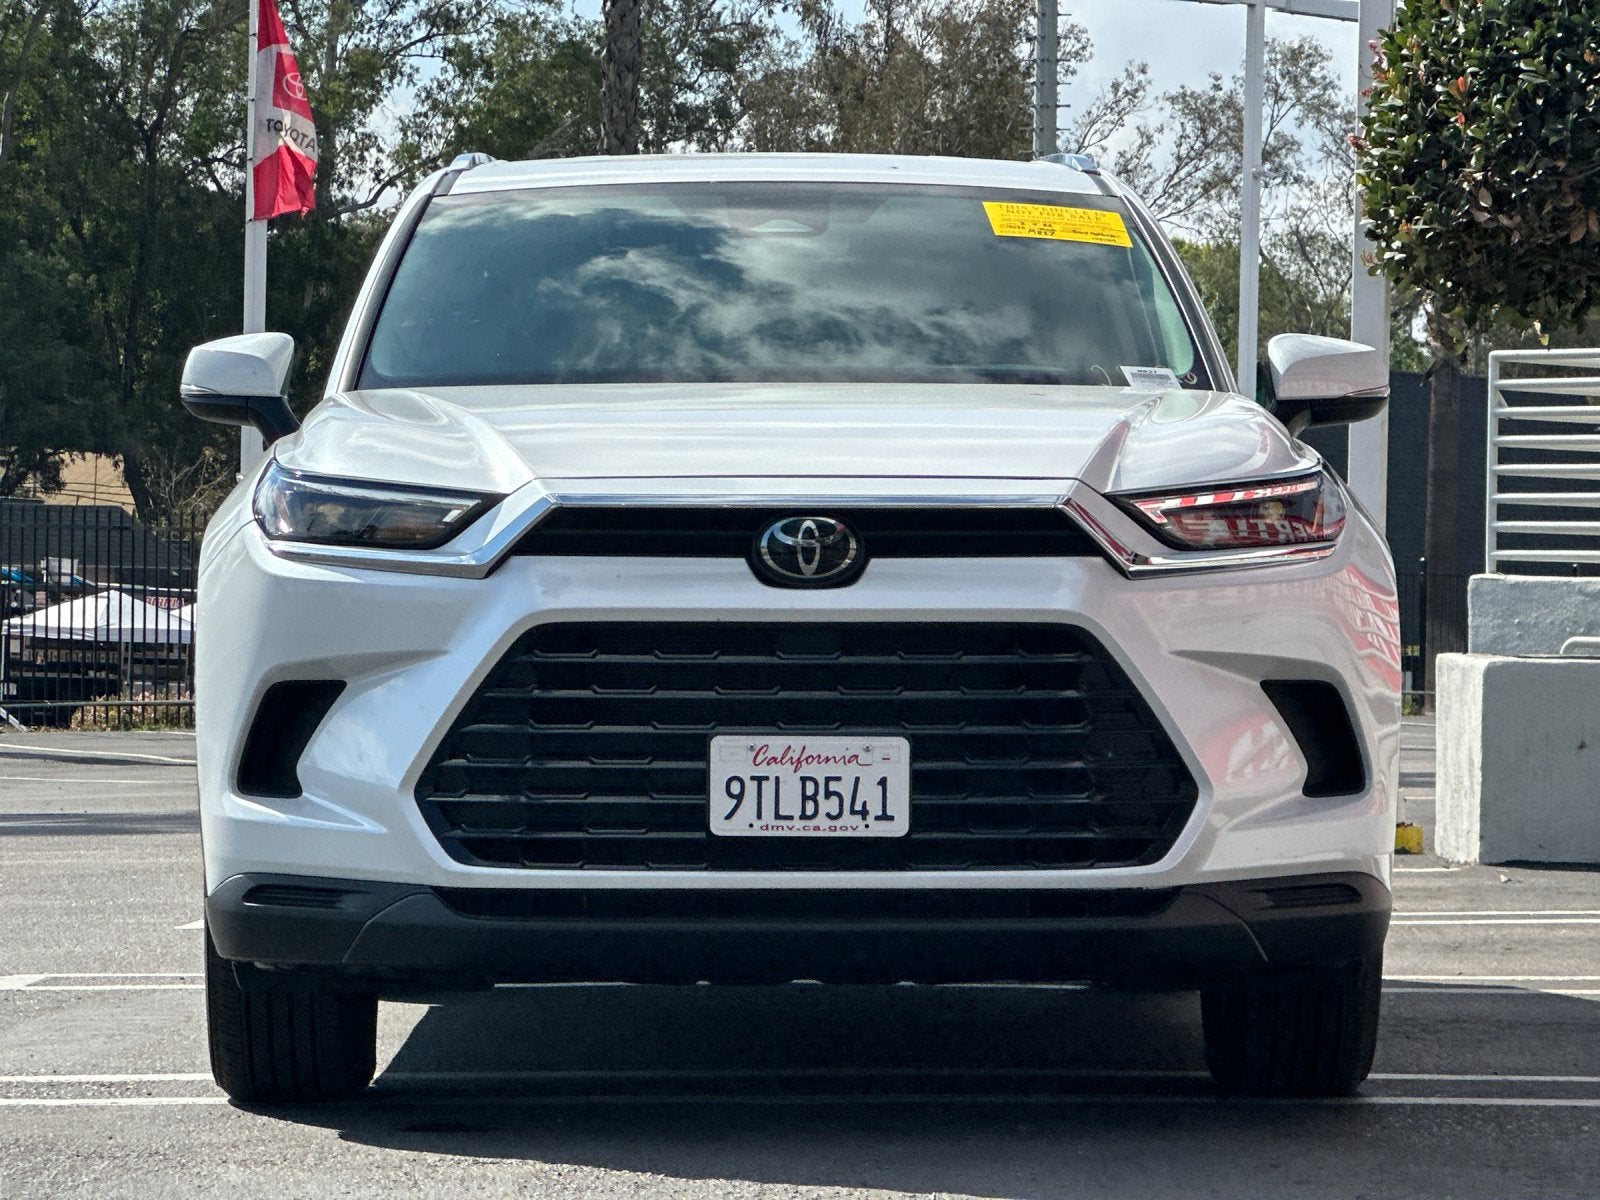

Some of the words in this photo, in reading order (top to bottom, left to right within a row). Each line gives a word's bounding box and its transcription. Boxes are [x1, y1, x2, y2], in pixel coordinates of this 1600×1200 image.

[266, 118, 316, 153] TOYOTA
[995, 203, 1028, 211] THIS
[1031, 205, 1089, 215] VEHICLE
[1070, 213, 1101, 221] SALE
[752, 744, 872, 774] California
[723, 775, 895, 821] 9TLB541
[759, 823, 859, 832] dmv.ca.gov
